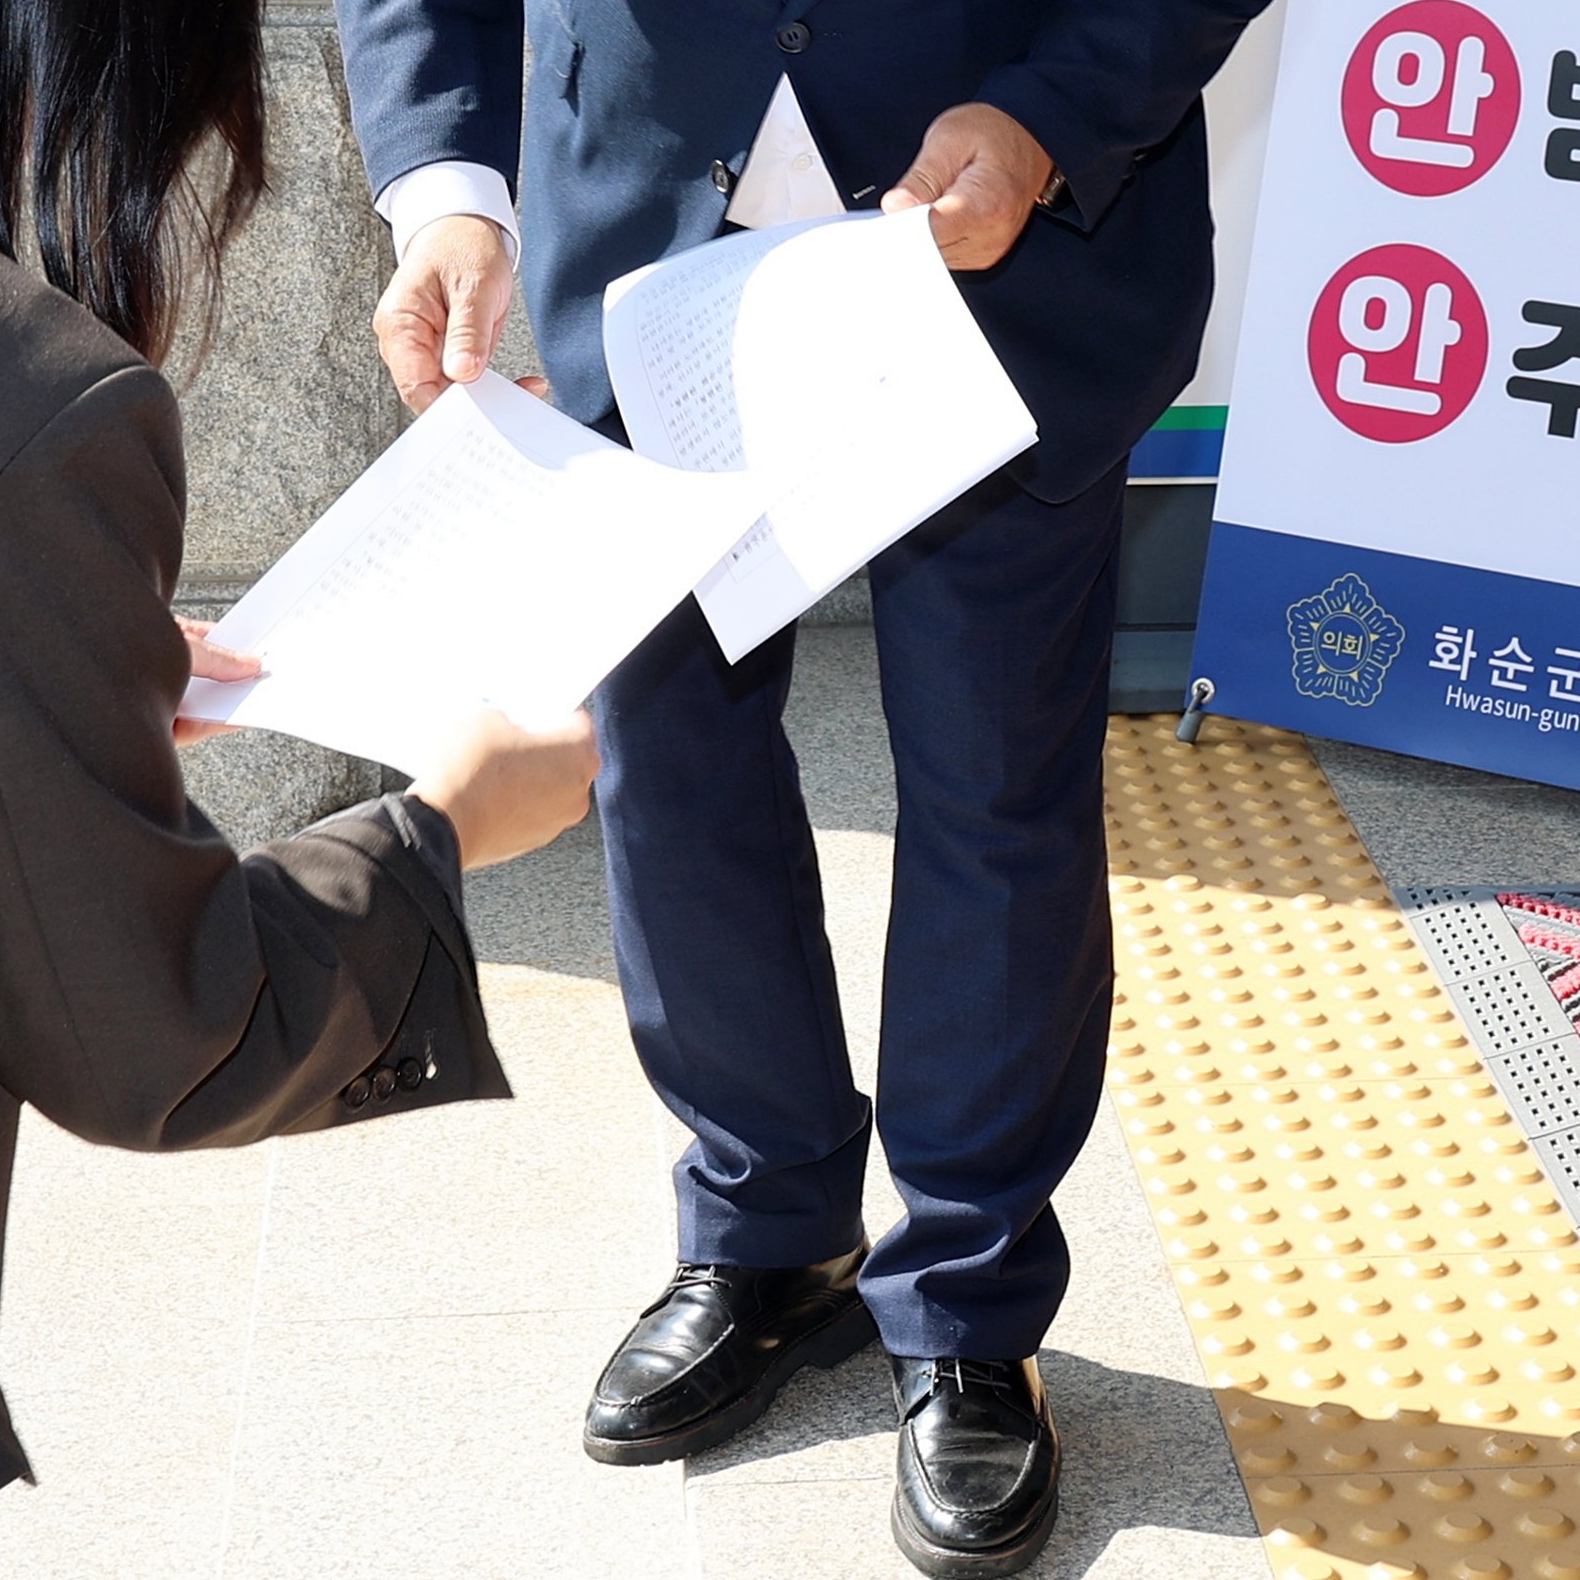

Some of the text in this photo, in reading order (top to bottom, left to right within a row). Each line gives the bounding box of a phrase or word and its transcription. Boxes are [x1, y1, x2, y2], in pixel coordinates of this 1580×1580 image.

[1368, 30, 1497, 170] 안
[1334, 274, 1464, 418] 안
[1321, 629, 1365, 661] 의회
